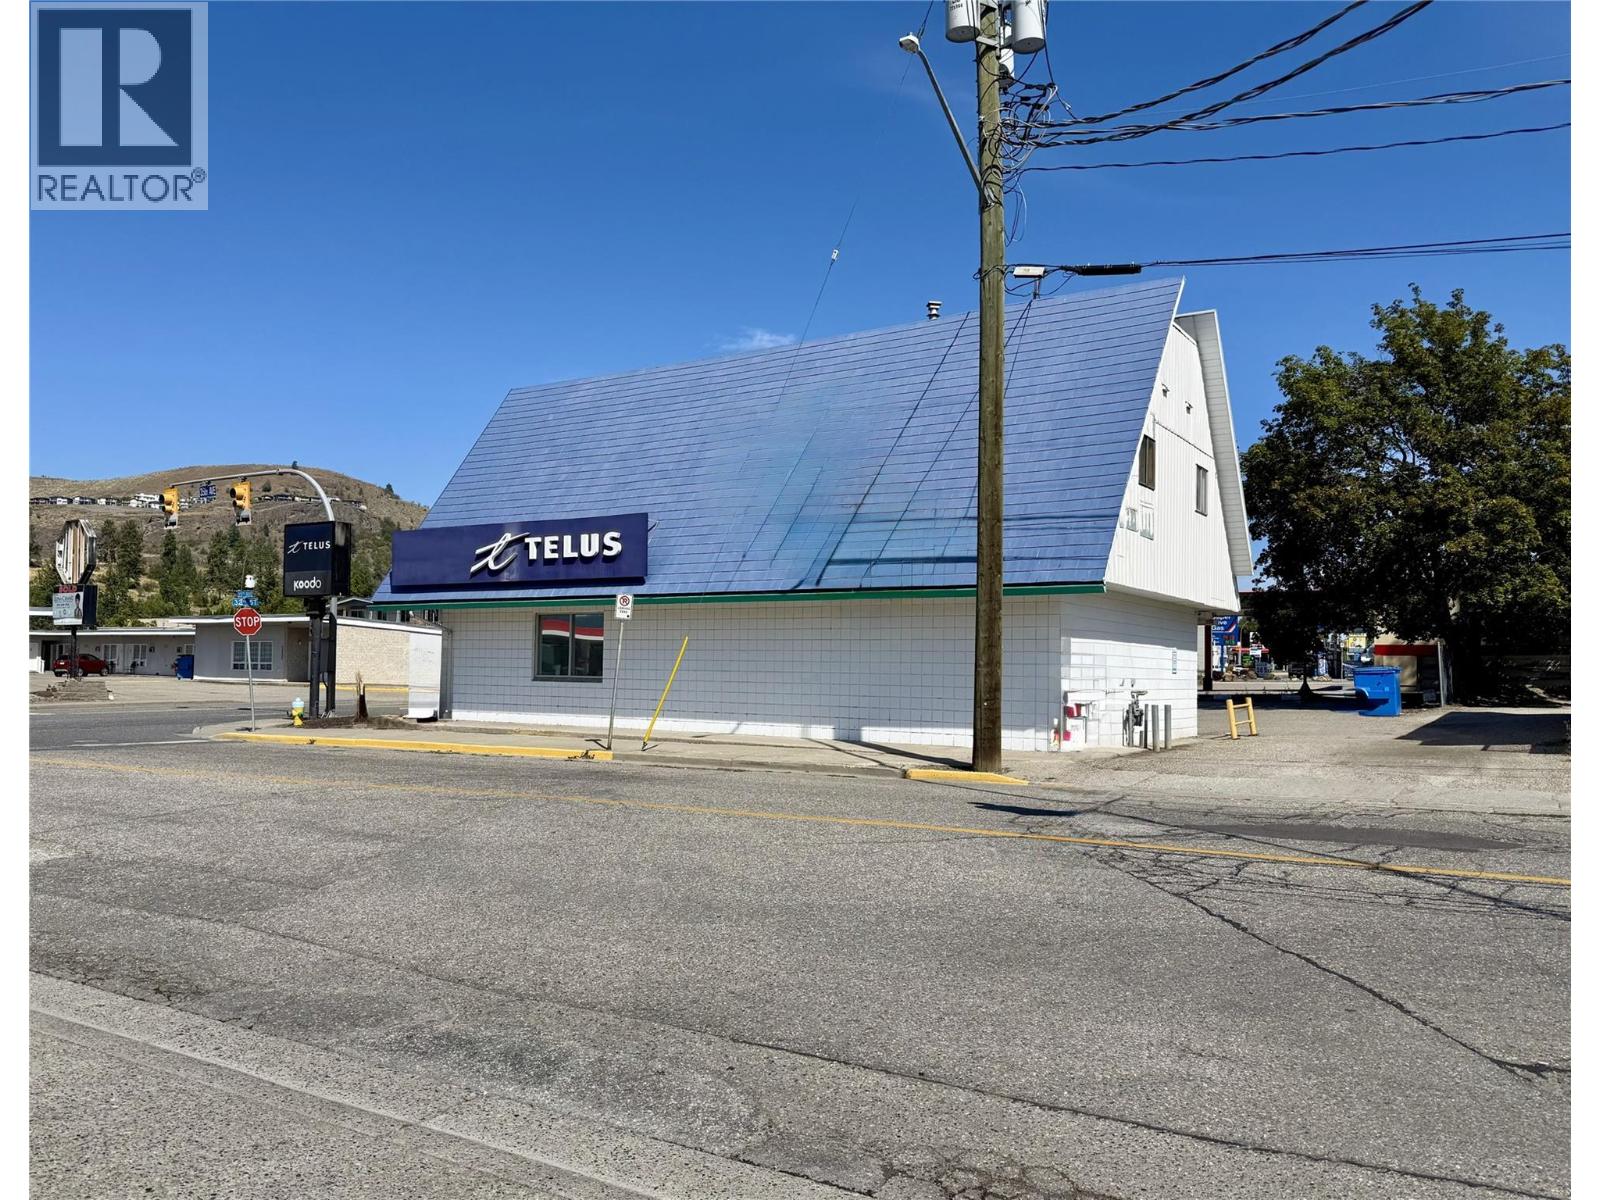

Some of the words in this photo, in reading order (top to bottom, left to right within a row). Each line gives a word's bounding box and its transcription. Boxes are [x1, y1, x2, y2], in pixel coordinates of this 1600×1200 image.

[303, 540, 331, 550] TELUS
[524, 531, 623, 561] TELUS
[235, 616, 260, 628] STOP
